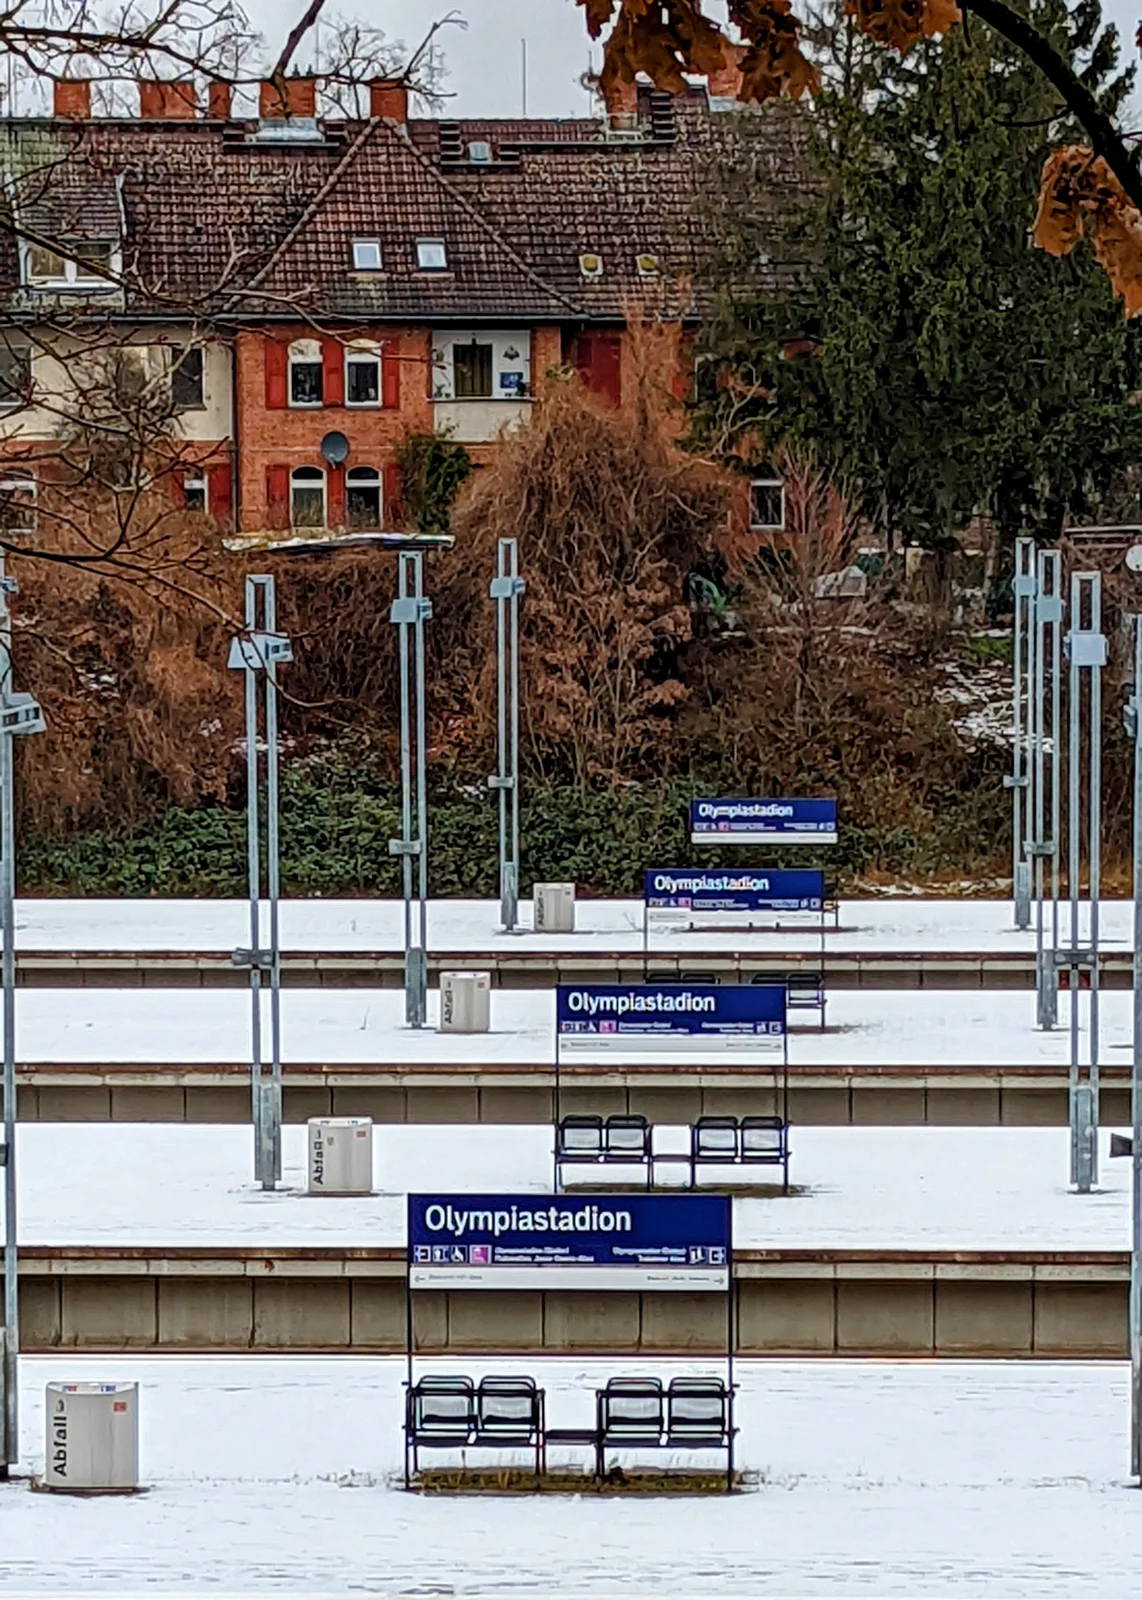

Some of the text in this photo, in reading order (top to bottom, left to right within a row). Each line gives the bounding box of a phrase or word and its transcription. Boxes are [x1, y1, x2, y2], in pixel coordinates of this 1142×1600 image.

[654, 875, 769, 893] Olympiastadion
[568, 991, 716, 1015] Olympiastadion
[424, 1204, 632, 1236] Olympiastadion
[53, 1415, 67, 1477] Abfall
